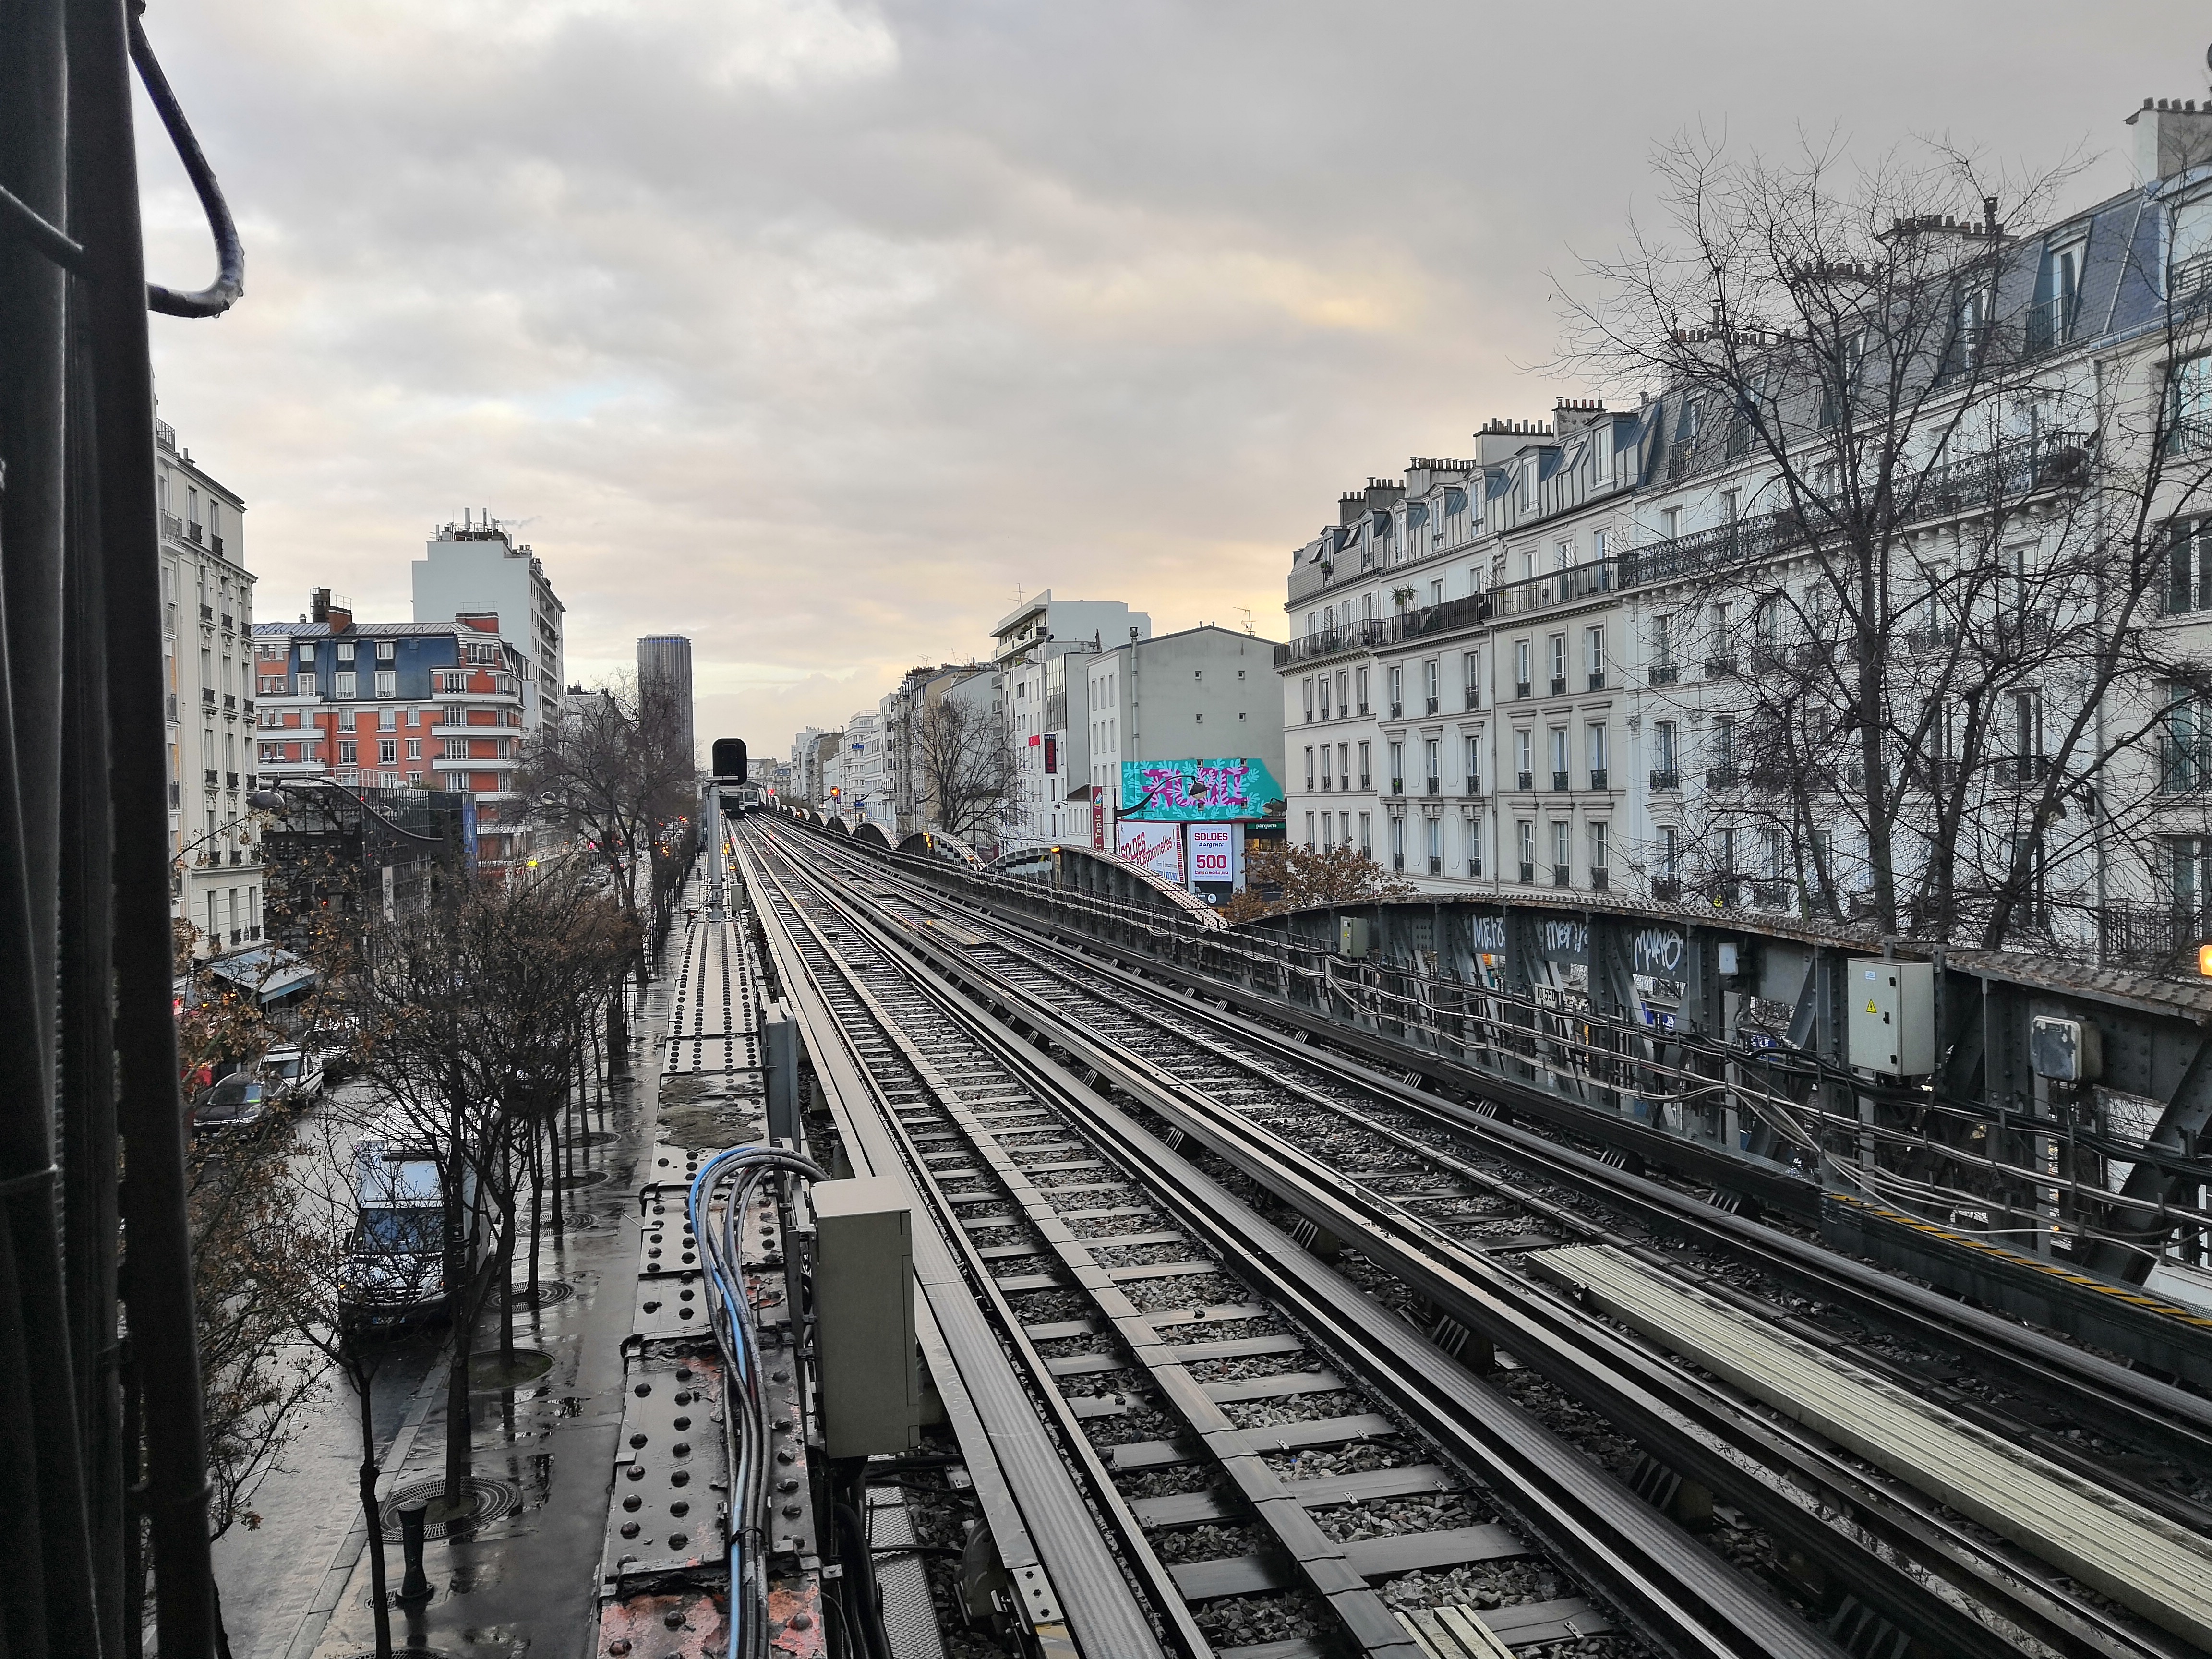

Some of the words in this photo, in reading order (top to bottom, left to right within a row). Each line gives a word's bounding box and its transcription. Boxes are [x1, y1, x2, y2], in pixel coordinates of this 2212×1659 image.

[1194, 832, 1228, 841] SOLDES
[1121, 831, 1146, 861] SOLDES
[1197, 854, 1226, 869] 500
[1538, 987, 1555, 1001] 10.550
